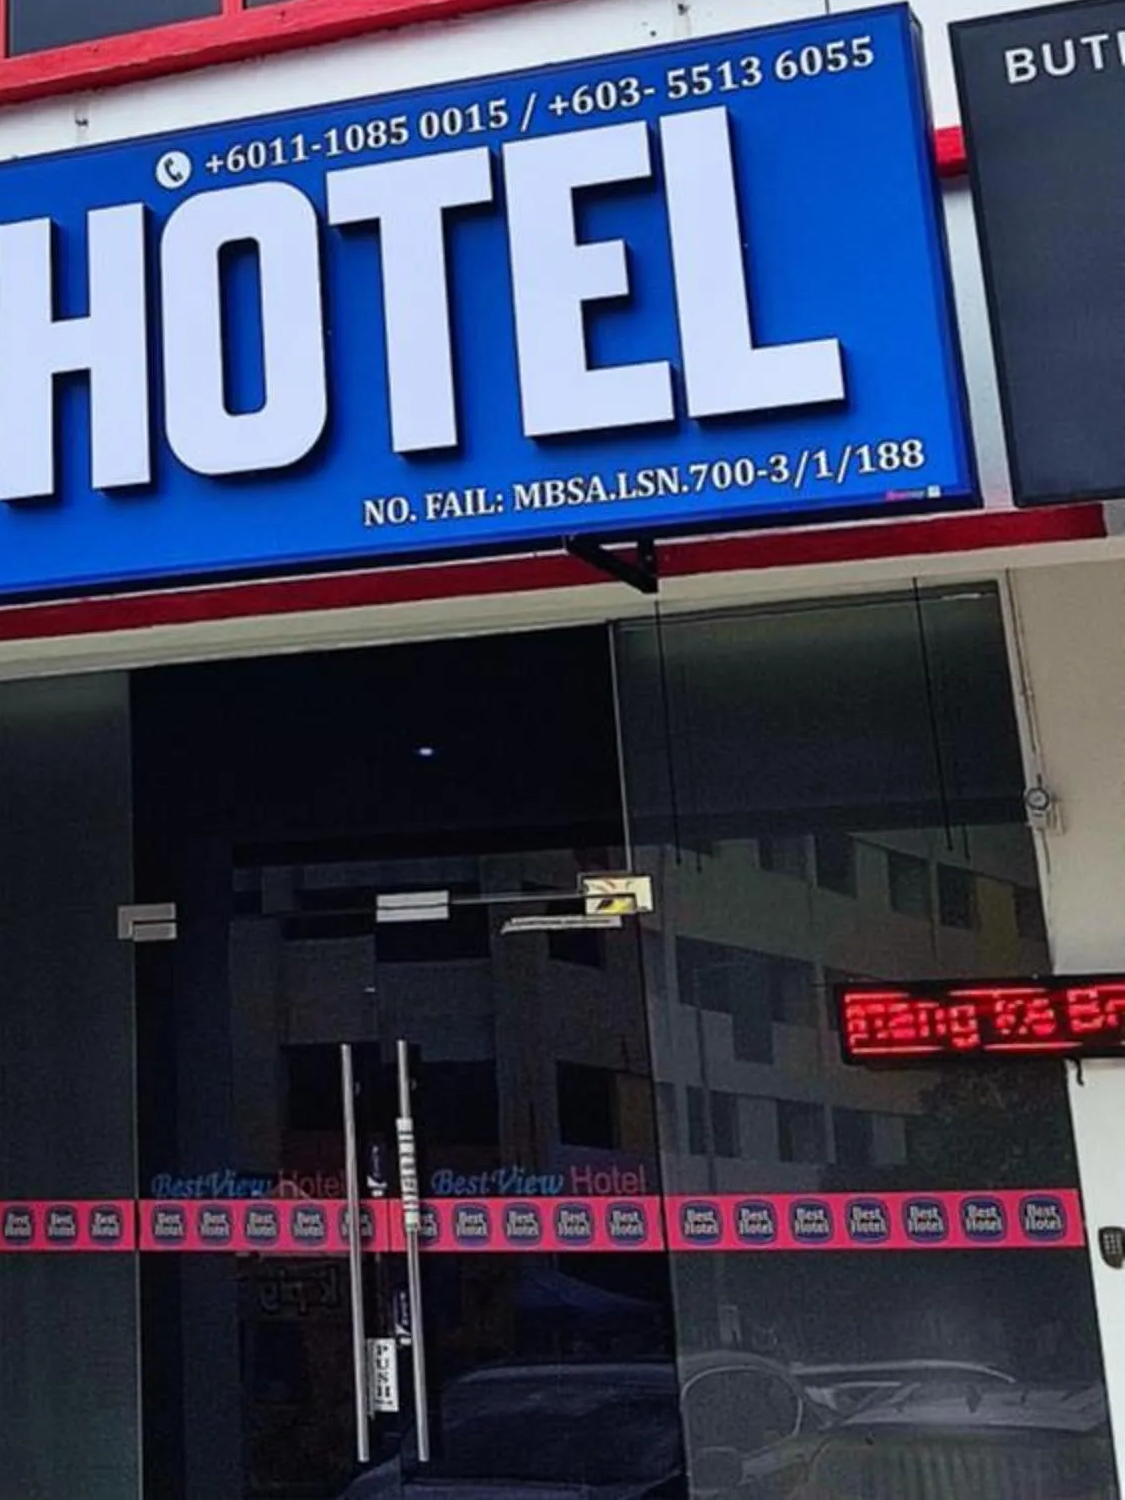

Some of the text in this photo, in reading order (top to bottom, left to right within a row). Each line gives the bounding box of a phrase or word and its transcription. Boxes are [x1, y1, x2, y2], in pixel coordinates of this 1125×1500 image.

[204, 116, 410, 176] +6011-1085
[420, 99, 508, 141] 0015
[548, 76, 656, 119] +603-
[667, 52, 763, 100] 5513
[775, 35, 874, 83] 6055
[363, 438, 925, 527] NO. FAIL: MBSA.LSN.700-3/1/188
[570, 1164, 648, 1195] Hotel
